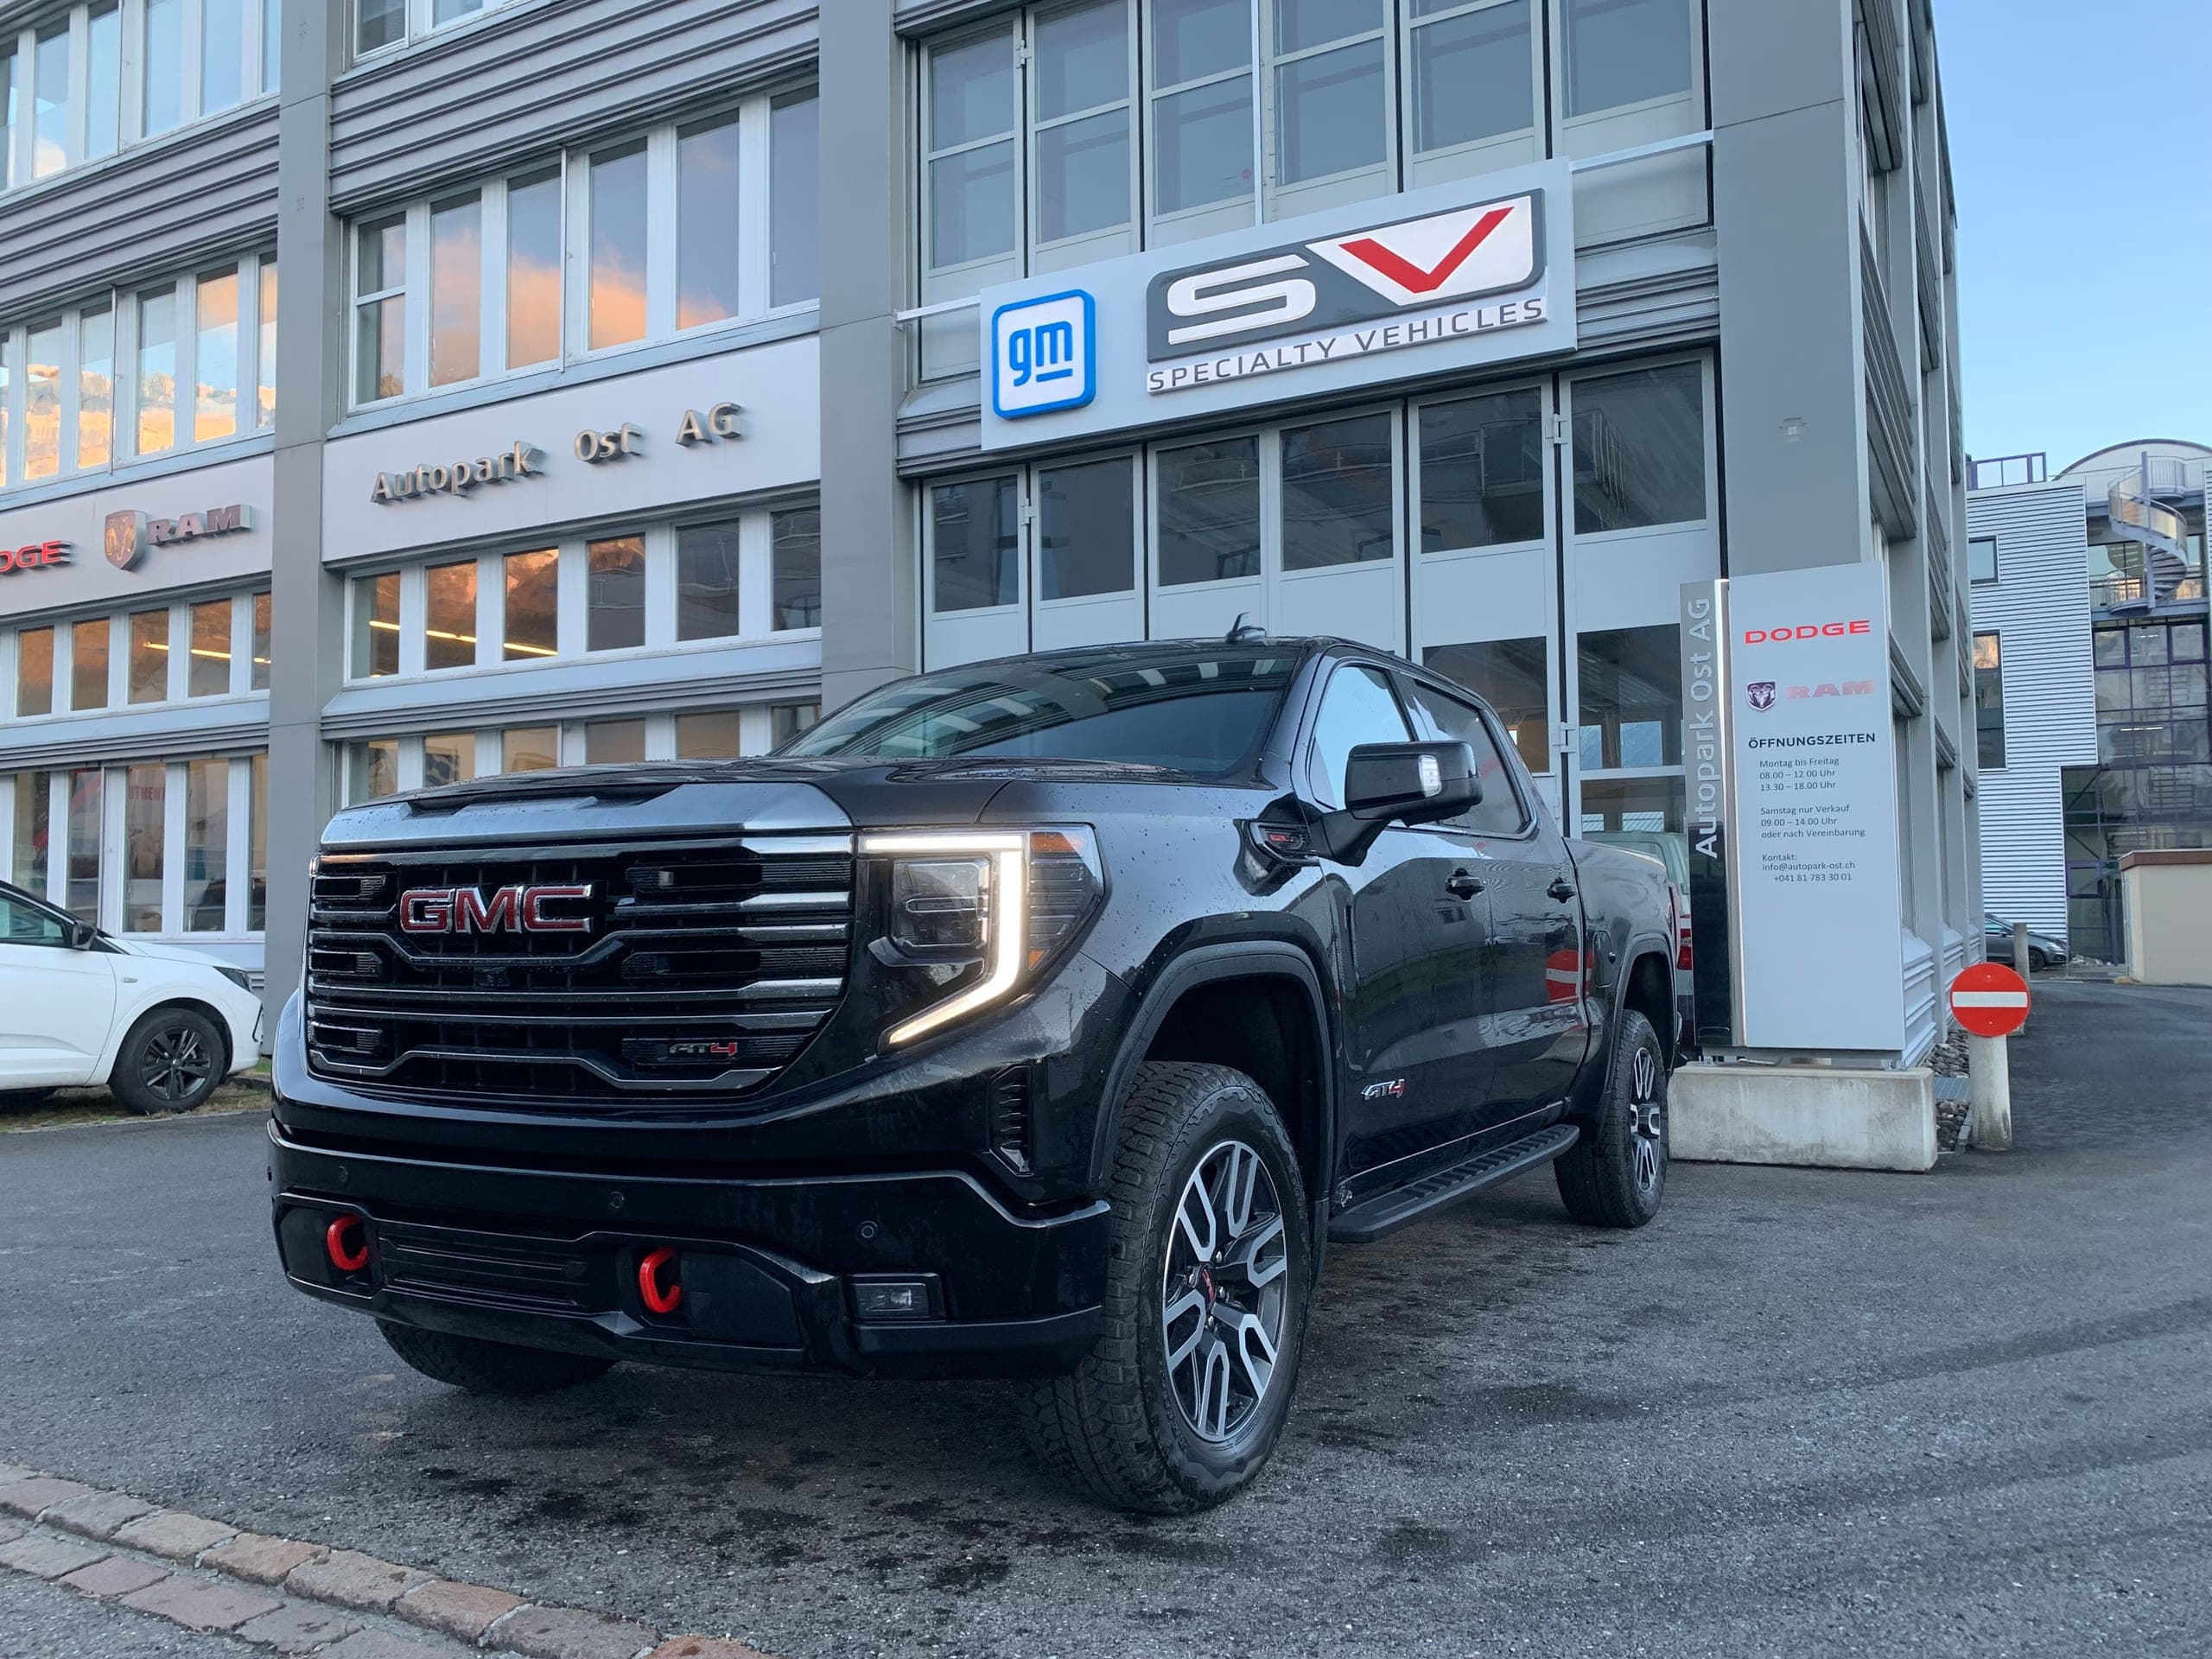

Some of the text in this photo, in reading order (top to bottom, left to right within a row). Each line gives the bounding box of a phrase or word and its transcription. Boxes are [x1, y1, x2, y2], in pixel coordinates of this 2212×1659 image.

[1149, 296, 1543, 391] SPECIALTY VEHICLES
[1008, 320, 1073, 387] gm
[371, 402, 741, 504] Autopark Ost AG
[146, 505, 248, 545] RAM
[1745, 620, 1871, 645] DODGE
[1787, 680, 1876, 701] RAM
[1688, 597, 1721, 859] Autopark Ost AG
[1748, 733, 1876, 749] ÖFFNUNGSZEITEN
[1809, 758, 1840, 766] Freitag
[1759, 771, 1784, 779] 08.00
[1794, 770, 1818, 779] 12.00
[1761, 783, 1784, 791] 13.30
[1760, 806, 1796, 816] Samstag
[1815, 804, 1850, 813] Verkauf
[1761, 818, 1785, 827] 09.00
[1796, 817, 1819, 826] 14.00
[1761, 829, 1866, 838] oder nach Vereinbarung
[1763, 861, 1856, 871] info@autopark-ost.ch
[1828, 873, 1839, 881] 30
[400, 884, 593, 935] GMC
[669, 1041, 738, 1057] AT4
[1360, 1077, 1405, 1100] AT4
